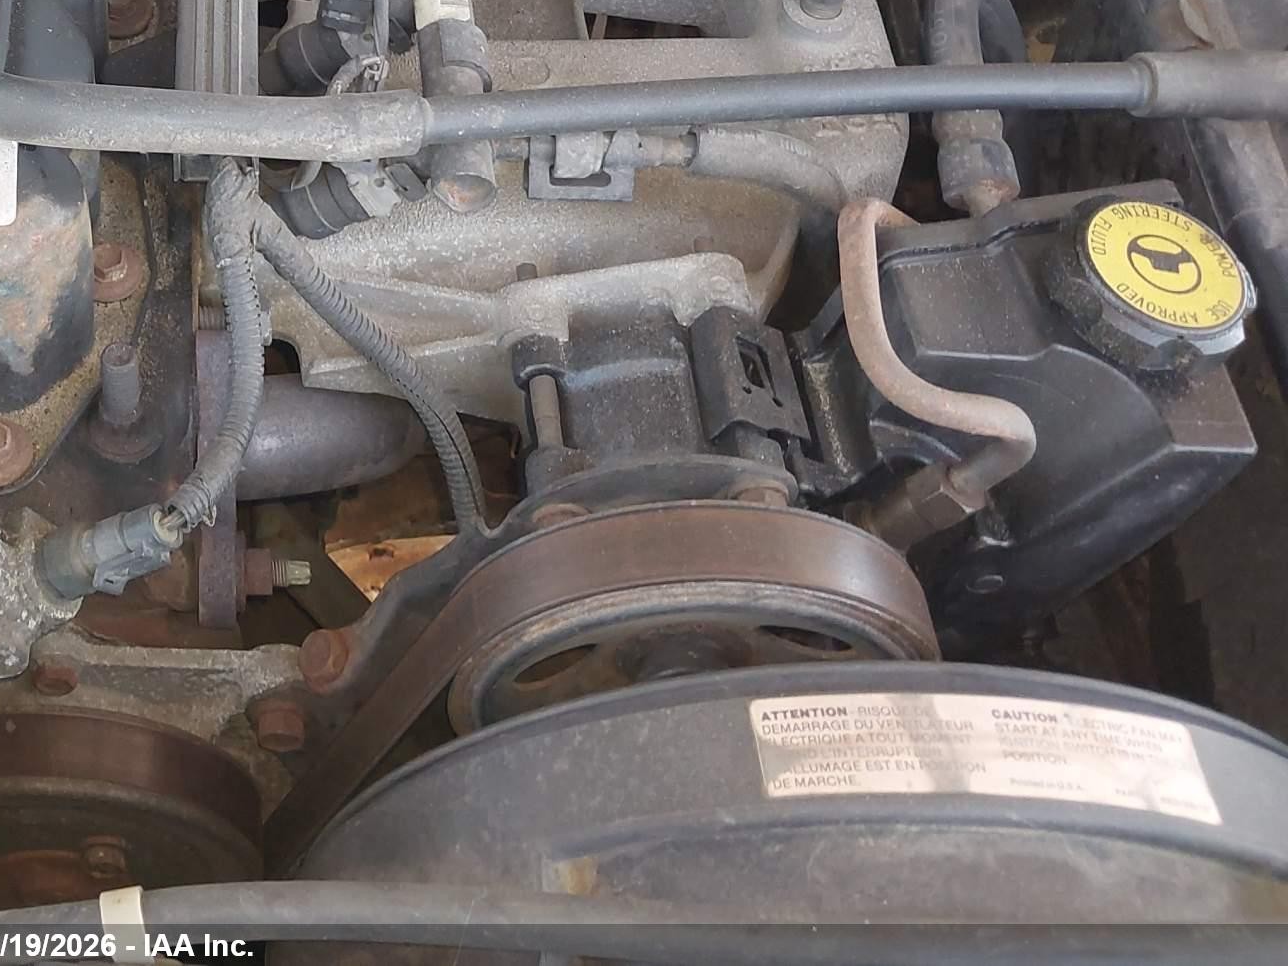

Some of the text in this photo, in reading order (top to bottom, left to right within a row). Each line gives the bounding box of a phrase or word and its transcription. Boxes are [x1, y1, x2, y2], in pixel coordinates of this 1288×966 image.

[1090, 204, 1238, 278] POWER STEERING FLUID
[1116, 282, 1234, 324] USE APPROVED
[762, 706, 848, 722] ATTENTION
[857, 706, 912, 718] RISQUE
[992, 709, 1058, 724] CAUTION
[762, 720, 850, 736] DEMARRAGE
[854, 720, 874, 731] DU
[995, 722, 1038, 735] START
[865, 761, 892, 773] EST
[894, 760, 916, 772] EN
[772, 778, 792, 790] DE
